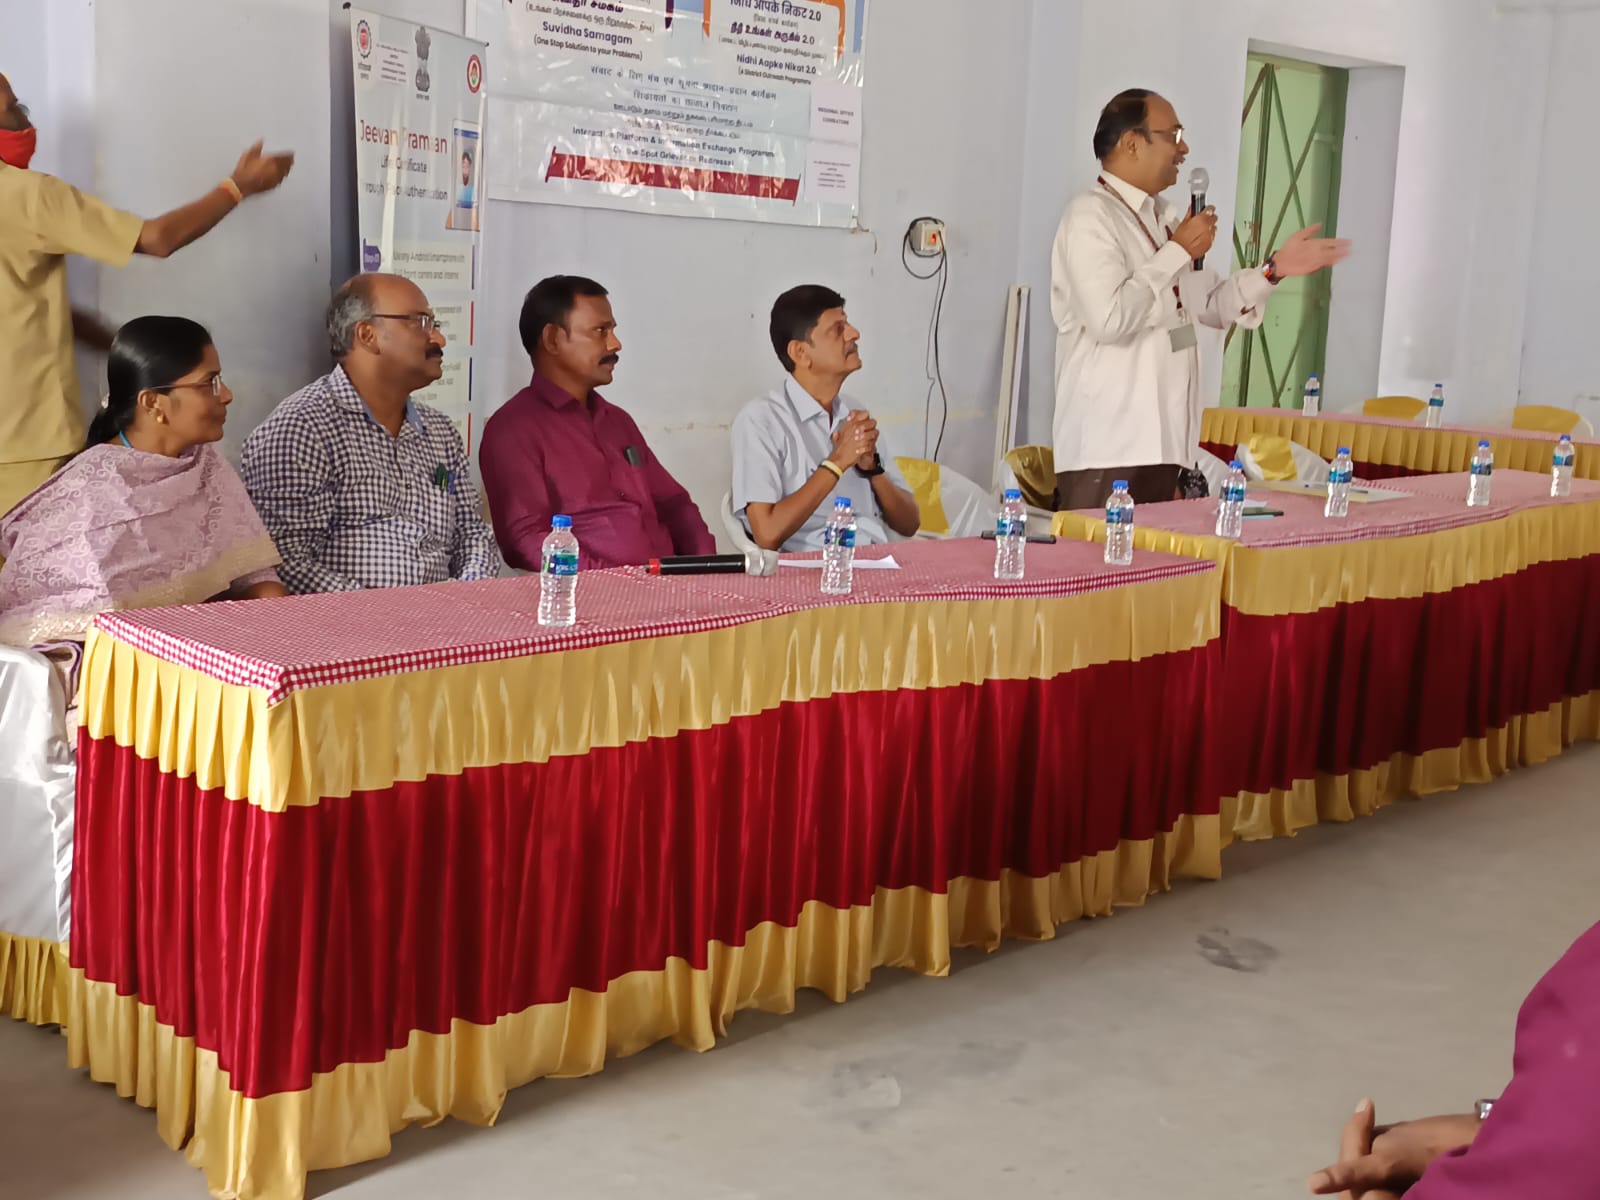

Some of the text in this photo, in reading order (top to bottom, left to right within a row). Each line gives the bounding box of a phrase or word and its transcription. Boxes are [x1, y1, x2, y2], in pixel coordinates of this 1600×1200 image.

[781, 1, 808, 18] निकट
[808, 9, 822, 21] 2.0
[542, 21, 582, 37] Suvidha
[583, 27, 633, 46] Samagam
[802, 34, 815, 45] 2.0
[550, 38, 564, 50] Stop
[565, 40, 590, 53] Solution
[590, 44, 597, 53] to
[597, 46, 612, 56] your
[736, 54, 817, 75] Nidhi Aapke Nikat 2.0
[401, 126, 448, 154] Praman
[572, 127, 615, 139] Interactie
[616, 131, 649, 143] Platform
[649, 135, 656, 145] &
[657, 136, 701, 150] Inrmation
[701, 142, 737, 155] Exchange
